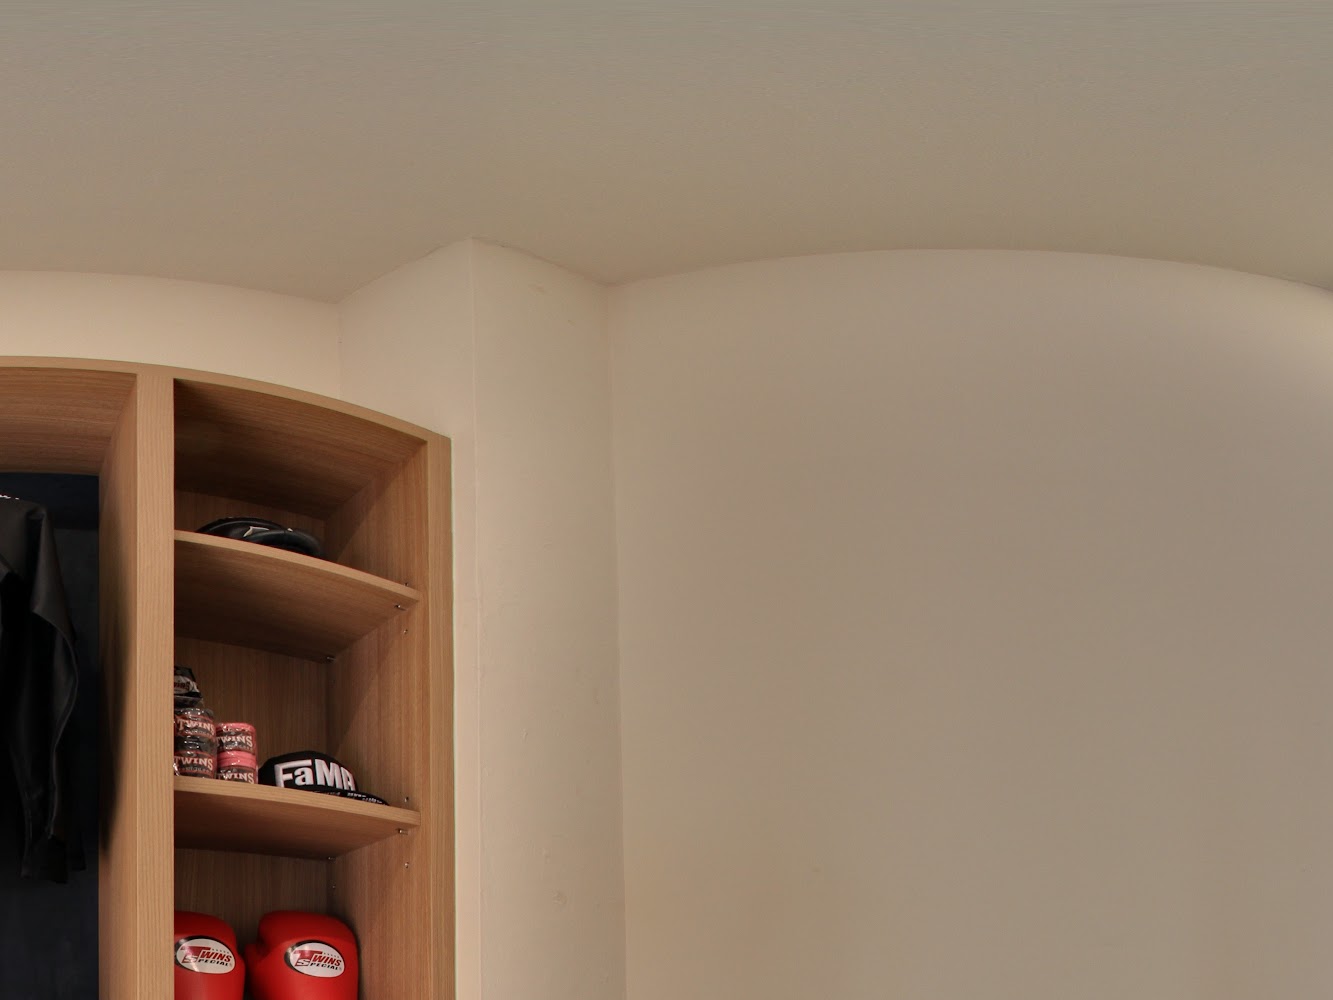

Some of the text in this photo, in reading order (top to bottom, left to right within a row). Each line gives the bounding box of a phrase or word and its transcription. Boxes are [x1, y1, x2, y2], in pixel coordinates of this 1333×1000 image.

[177, 719, 215, 736] TWINS
[175, 756, 214, 772] TWINS
[274, 759, 356, 792] FaMA
[183, 945, 233, 963] TWINS
[183, 955, 230, 967] SPECIAL
[294, 949, 342, 967] TWINS
[296, 957, 340, 971] SPECIAL
